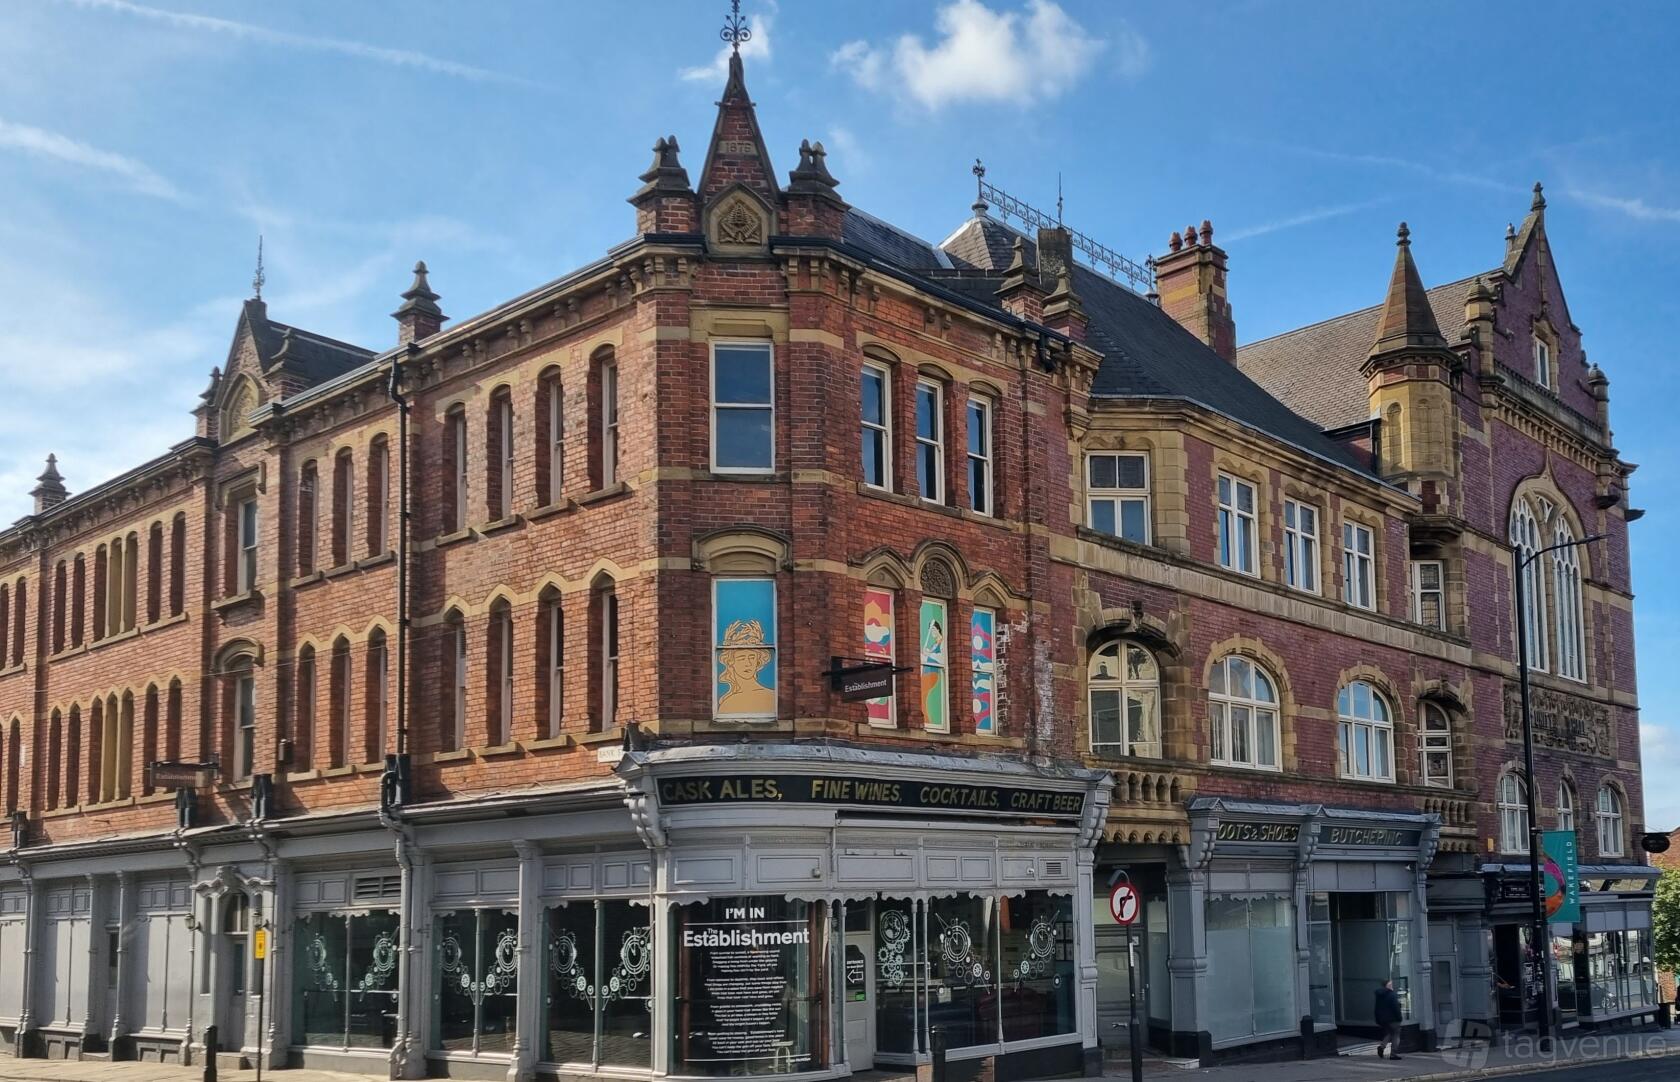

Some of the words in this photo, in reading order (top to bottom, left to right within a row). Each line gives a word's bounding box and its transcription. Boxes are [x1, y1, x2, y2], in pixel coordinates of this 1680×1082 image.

[844, 679, 887, 693] Establishment
[662, 781, 713, 801] CASK
[720, 779, 783, 801] ALES,
[811, 779, 851, 799] FINE
[920, 786, 1000, 808] COCKTAILS,
[1011, 791, 1051, 810] CRAFT
[1052, 794, 1081, 811] BEER
[1218, 823, 1252, 840] OOTS
[1260, 824, 1298, 841] SHOES
[1566, 841, 1575, 905] WAKEFIELD
[749, 907, 765, 919] IN
[683, 928, 810, 947] Establishment
